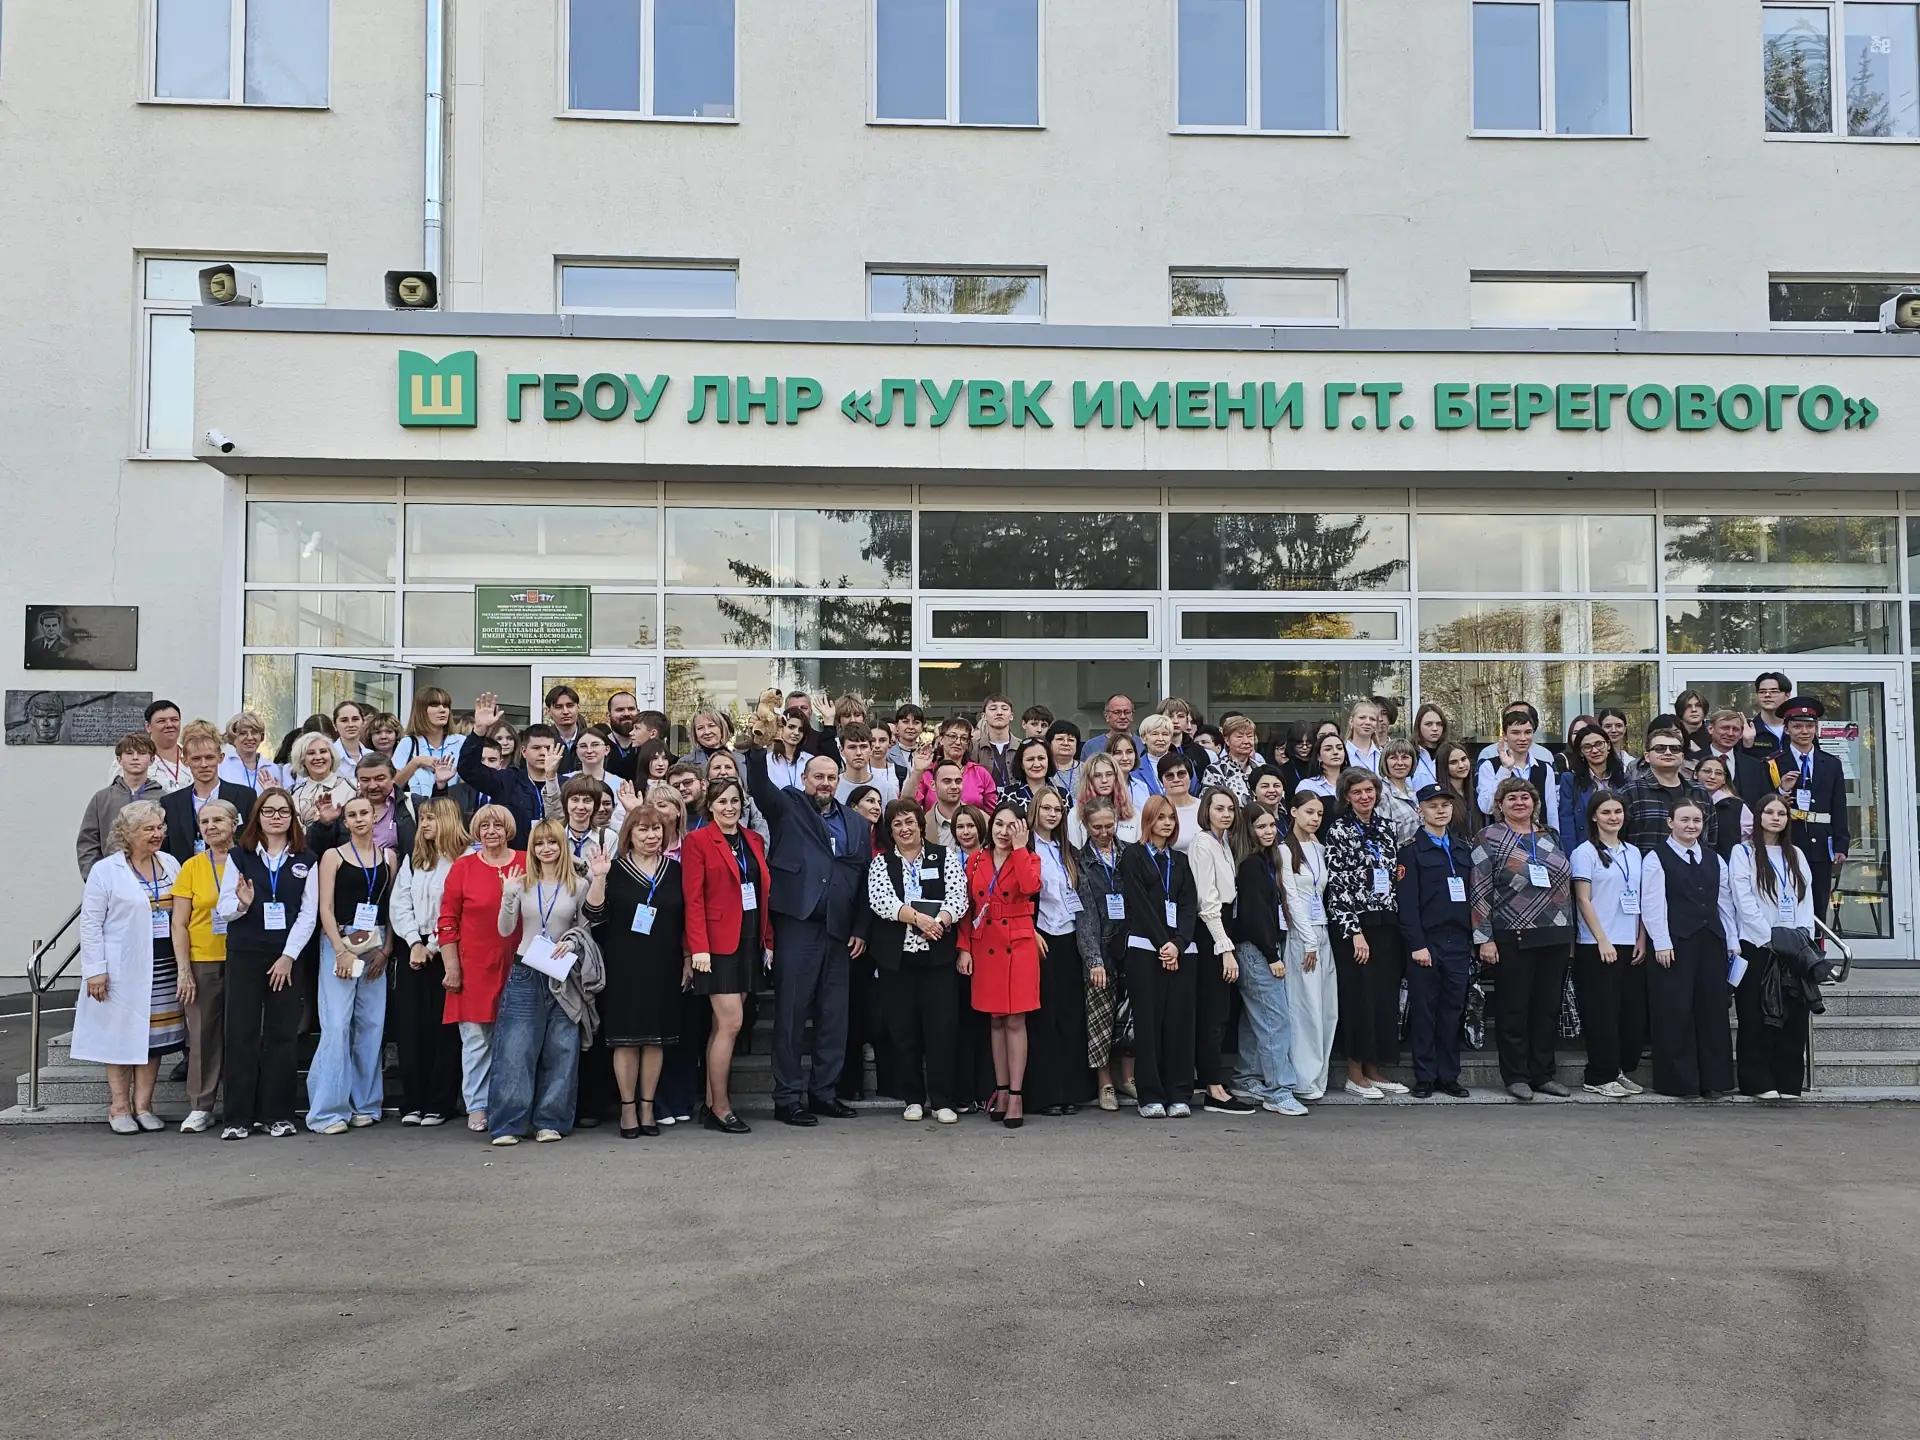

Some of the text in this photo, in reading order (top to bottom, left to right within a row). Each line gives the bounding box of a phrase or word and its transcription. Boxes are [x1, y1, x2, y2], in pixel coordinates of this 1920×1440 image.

[506, 373, 1880, 431] ГБОУ ЛНР «ЛУВК ИМЕНИ Г.Т. БЕРЕГОВОГО»
